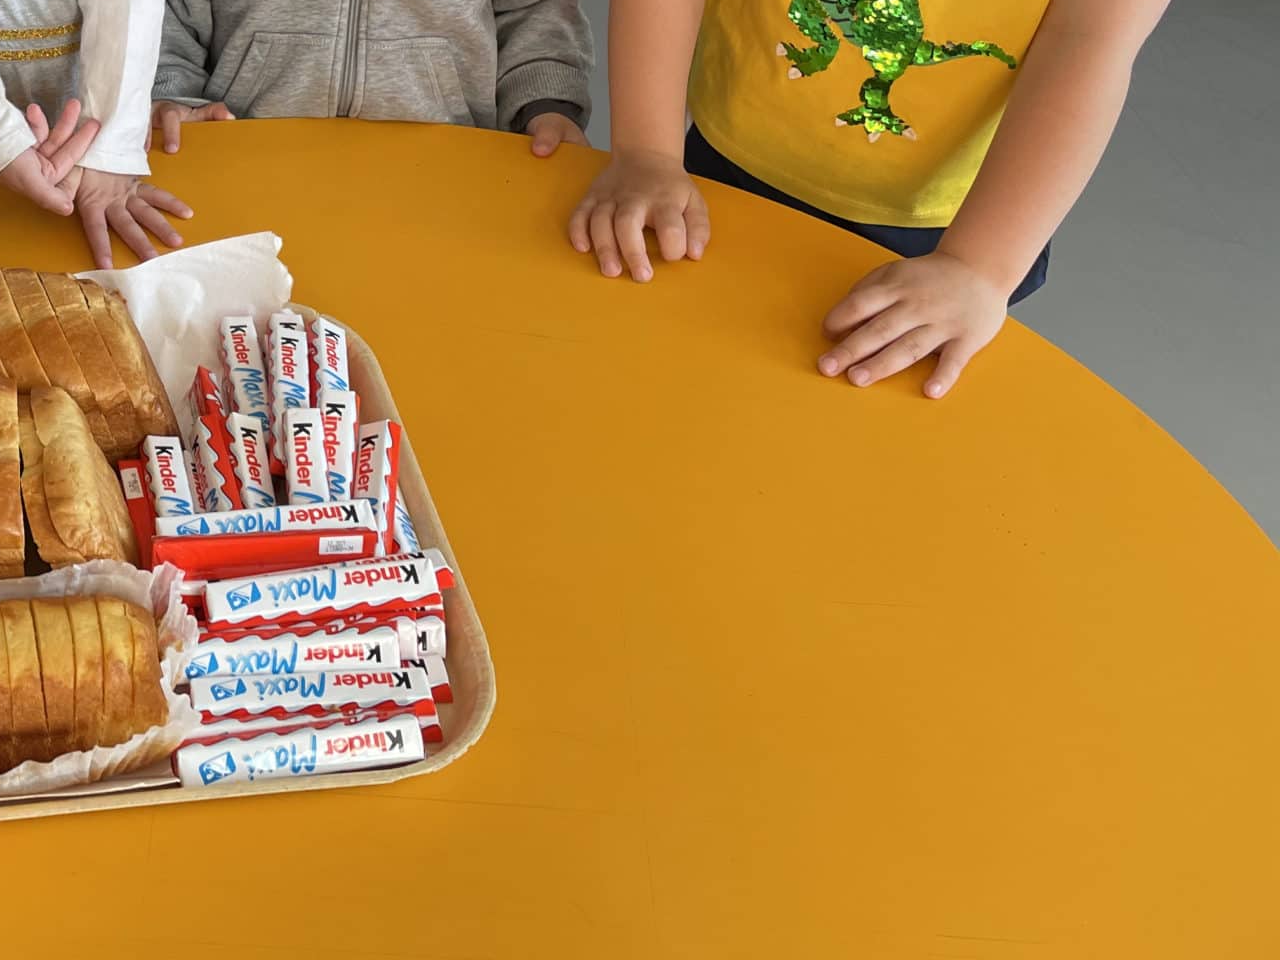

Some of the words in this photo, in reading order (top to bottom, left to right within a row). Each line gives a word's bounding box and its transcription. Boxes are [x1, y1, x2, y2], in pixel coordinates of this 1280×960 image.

[230, 325, 250, 364] Kinder
[281, 337, 300, 379] Kinder
[324, 328, 341, 372] Kinder
[233, 367, 269, 408] Maxi
[293, 422, 313, 487] Kinder
[323, 403, 346, 466] Kinder
[154, 446, 177, 493] Kinder
[241, 426, 263, 486] Kinder
[357, 434, 379, 492] Kinder
[288, 505, 359, 524] Kinder
[267, 568, 337, 607] Maxi
[344, 564, 419, 587] Kinder
[225, 642, 298, 675] Maxi
[304, 641, 381, 663] Kinder
[252, 672, 326, 701] Maxi
[333, 671, 412, 690] Kinder
[242, 734, 317, 781] Mai
[324, 728, 404, 758] Kinder
